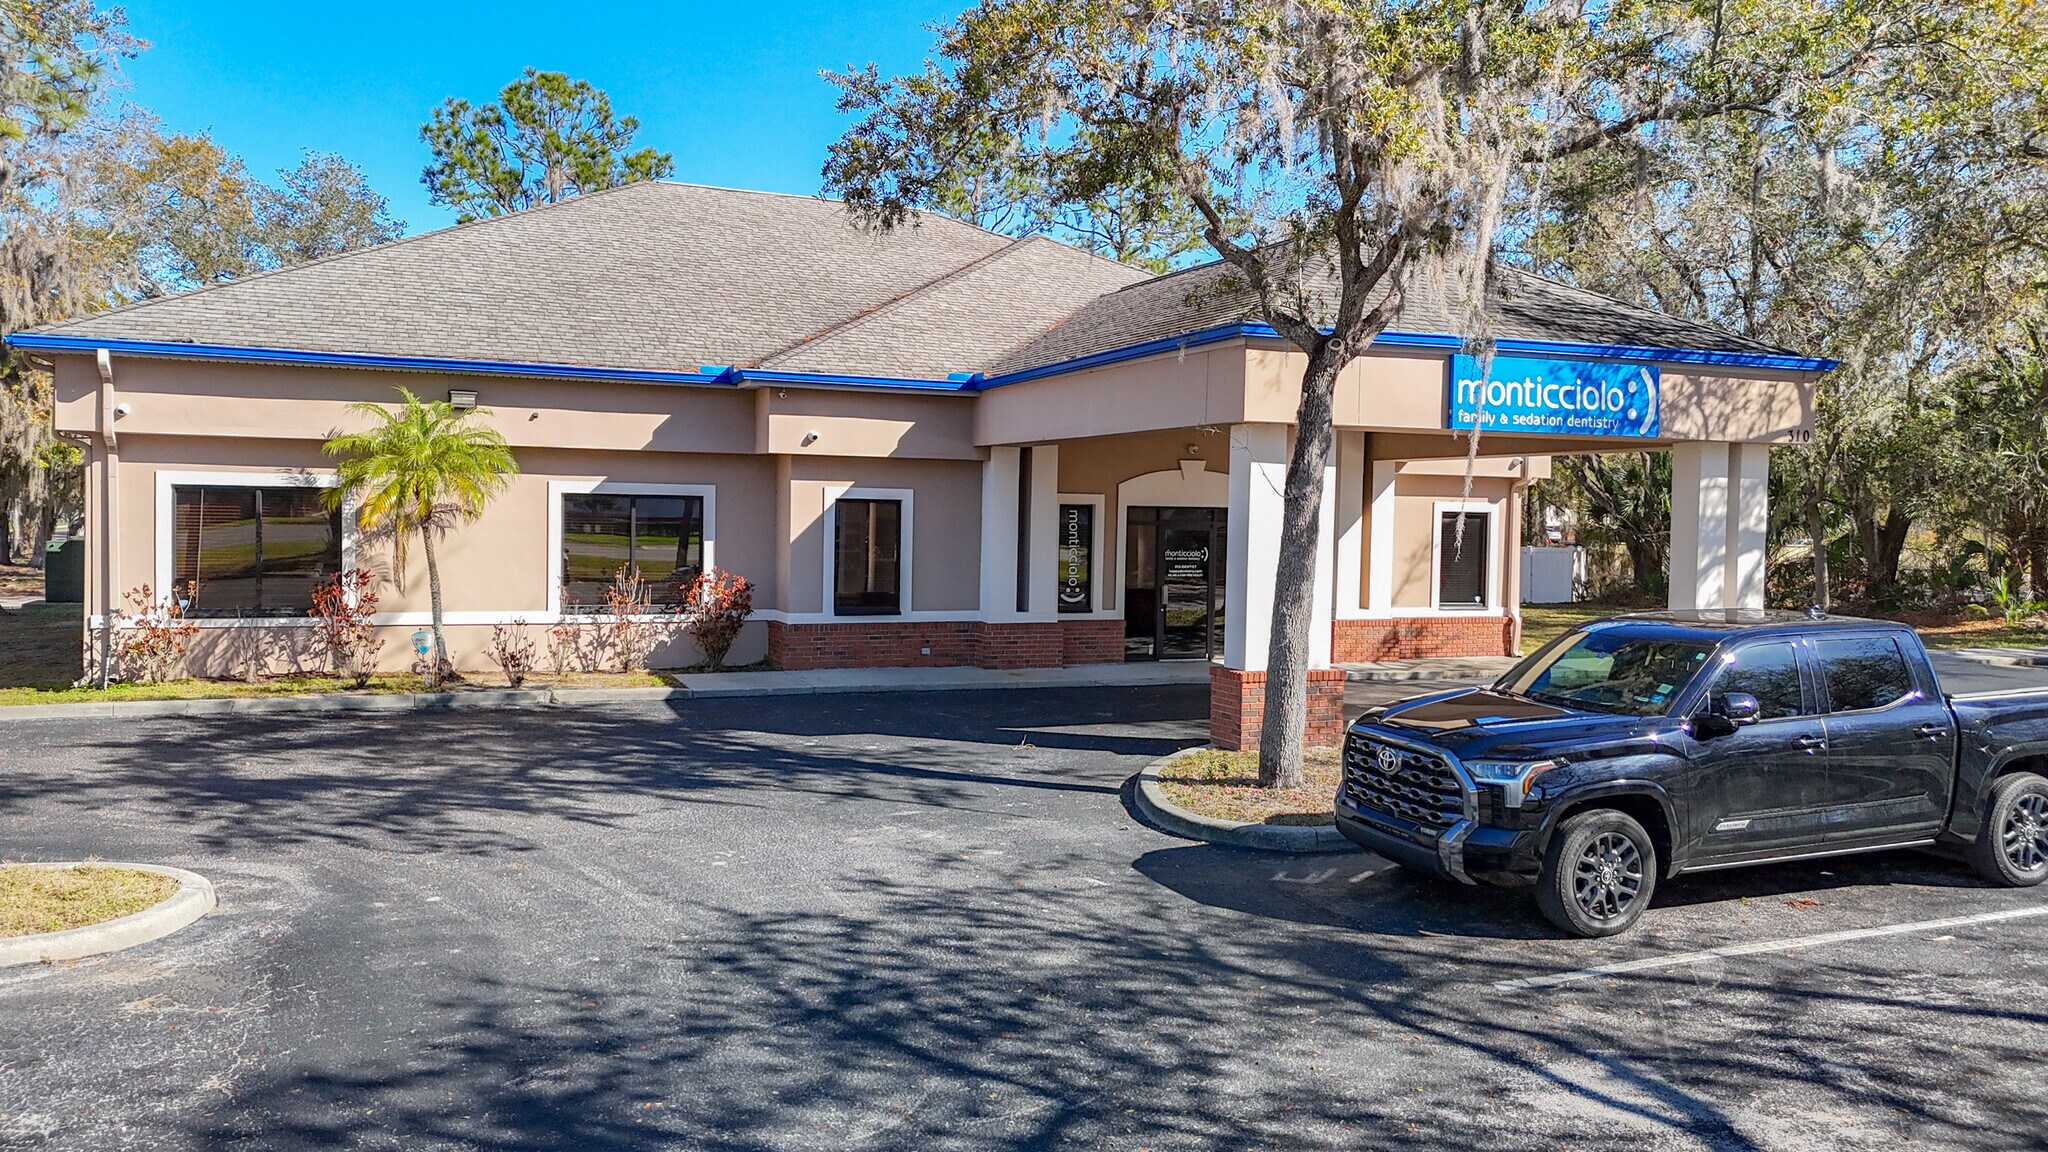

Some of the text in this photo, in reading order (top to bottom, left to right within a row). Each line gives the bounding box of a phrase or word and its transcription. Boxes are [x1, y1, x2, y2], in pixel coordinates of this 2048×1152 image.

[1458, 376, 1624, 412] monticciolo
[1500, 413, 1508, 425] &
[1512, 413, 1563, 427] sedation
[1567, 414, 1619, 432] dentistry
[1788, 429, 1810, 443] 310
[1068, 509, 1080, 587] monticciolo
